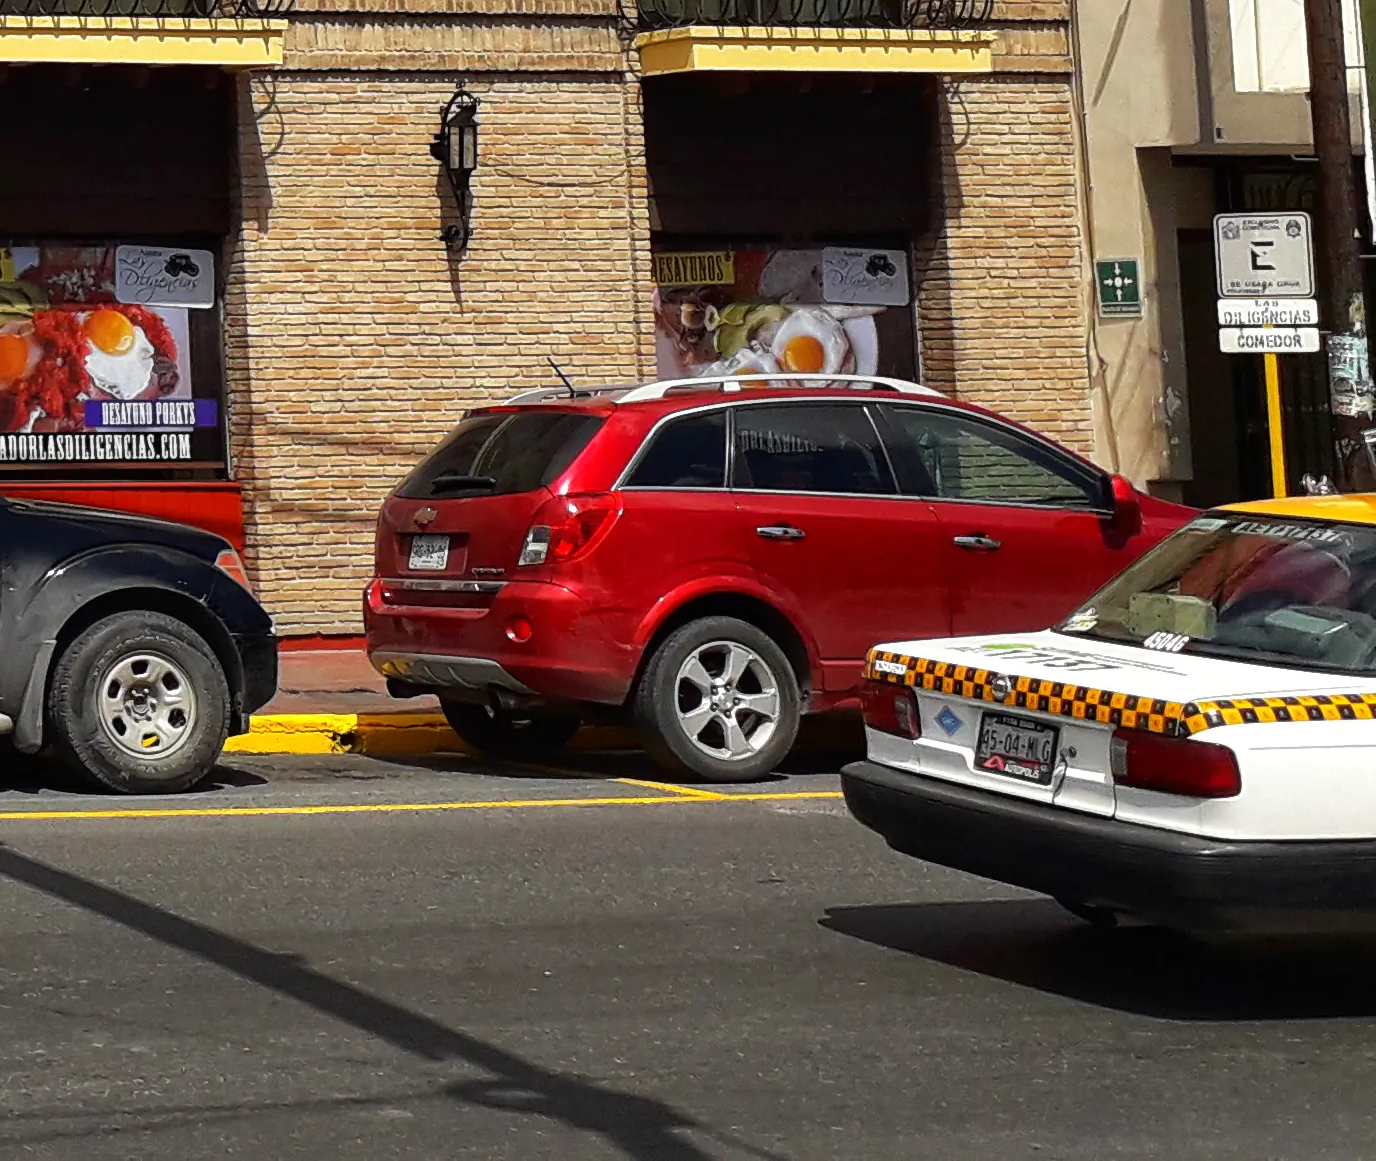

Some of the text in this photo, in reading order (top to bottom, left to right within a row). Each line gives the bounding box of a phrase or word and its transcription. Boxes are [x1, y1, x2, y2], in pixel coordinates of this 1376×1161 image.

[1224, 310, 1311, 324] DILIGENCIAS
[1237, 334, 1302, 348] COMEDOR
[102, 401, 196, 426] DESAYUNO PORKYS
